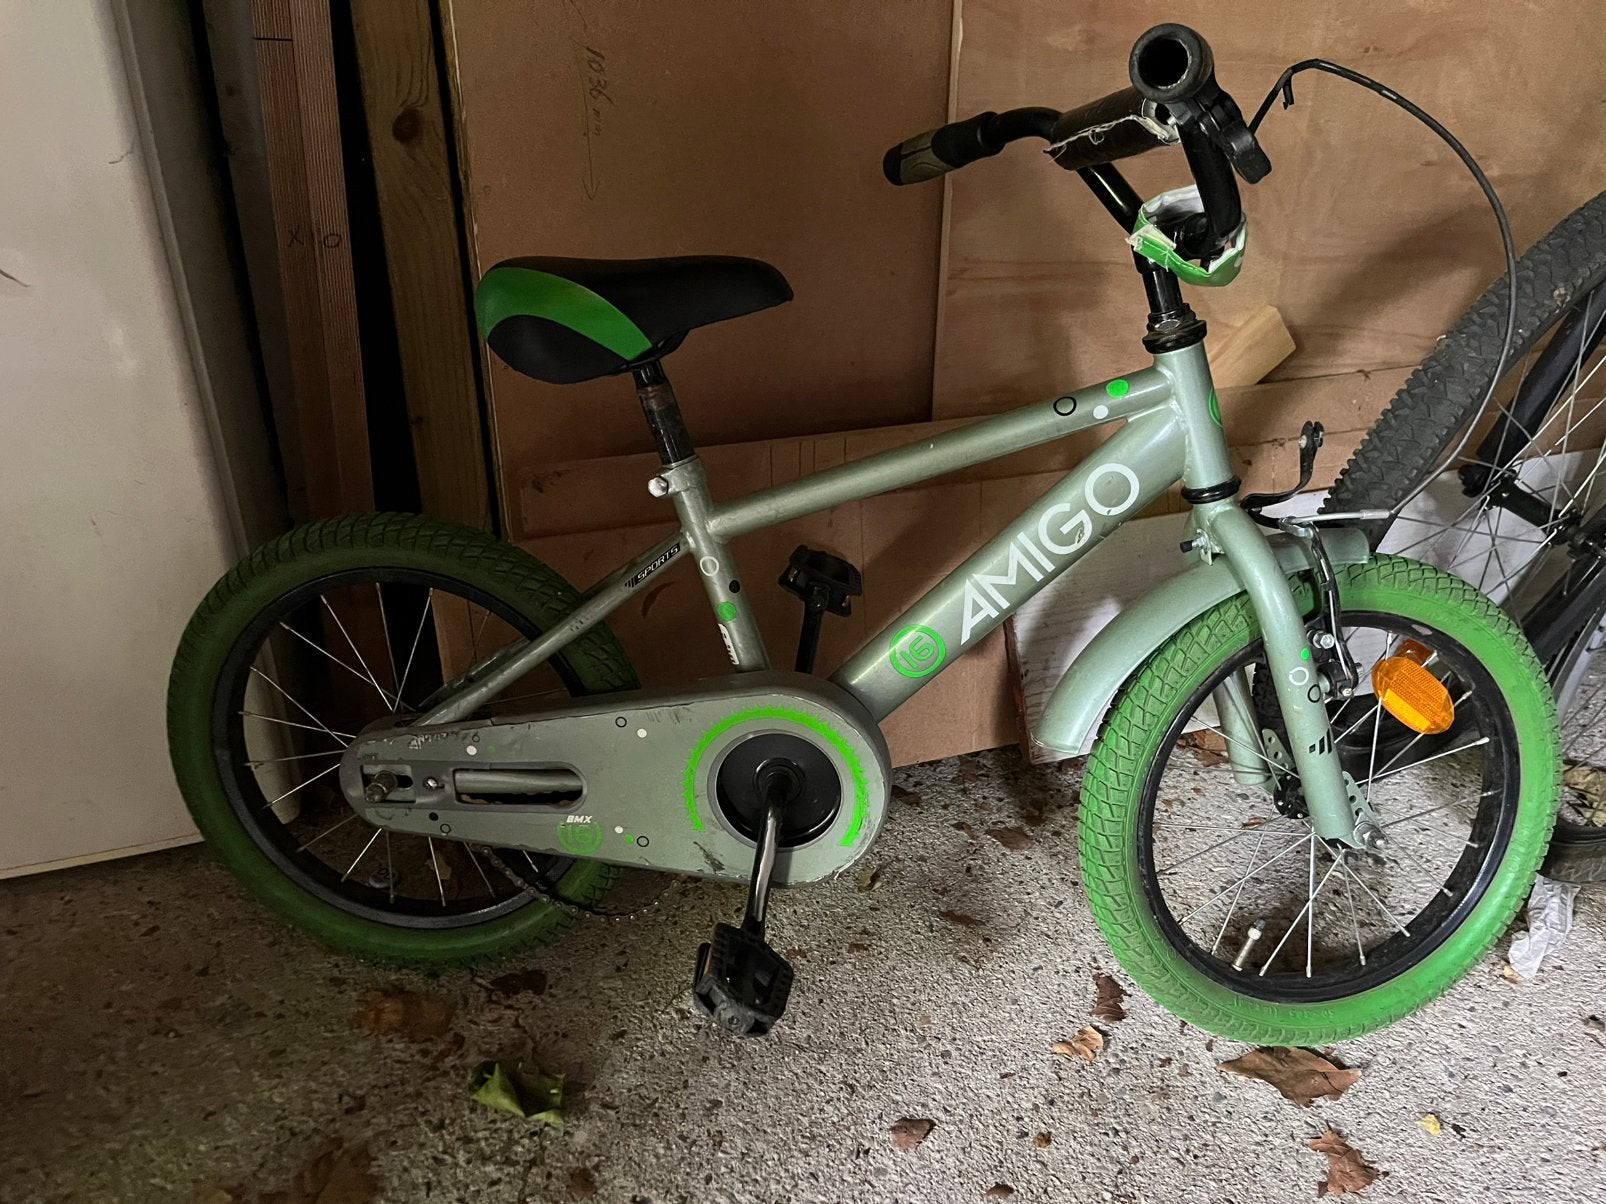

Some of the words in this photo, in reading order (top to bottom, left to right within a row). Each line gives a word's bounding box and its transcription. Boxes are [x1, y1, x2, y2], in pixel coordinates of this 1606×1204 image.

[637, 544, 679, 582] SPORTS
[960, 462, 1140, 646] AMIGO
[901, 636, 935, 669] 16
[566, 814, 593, 824] BMX
